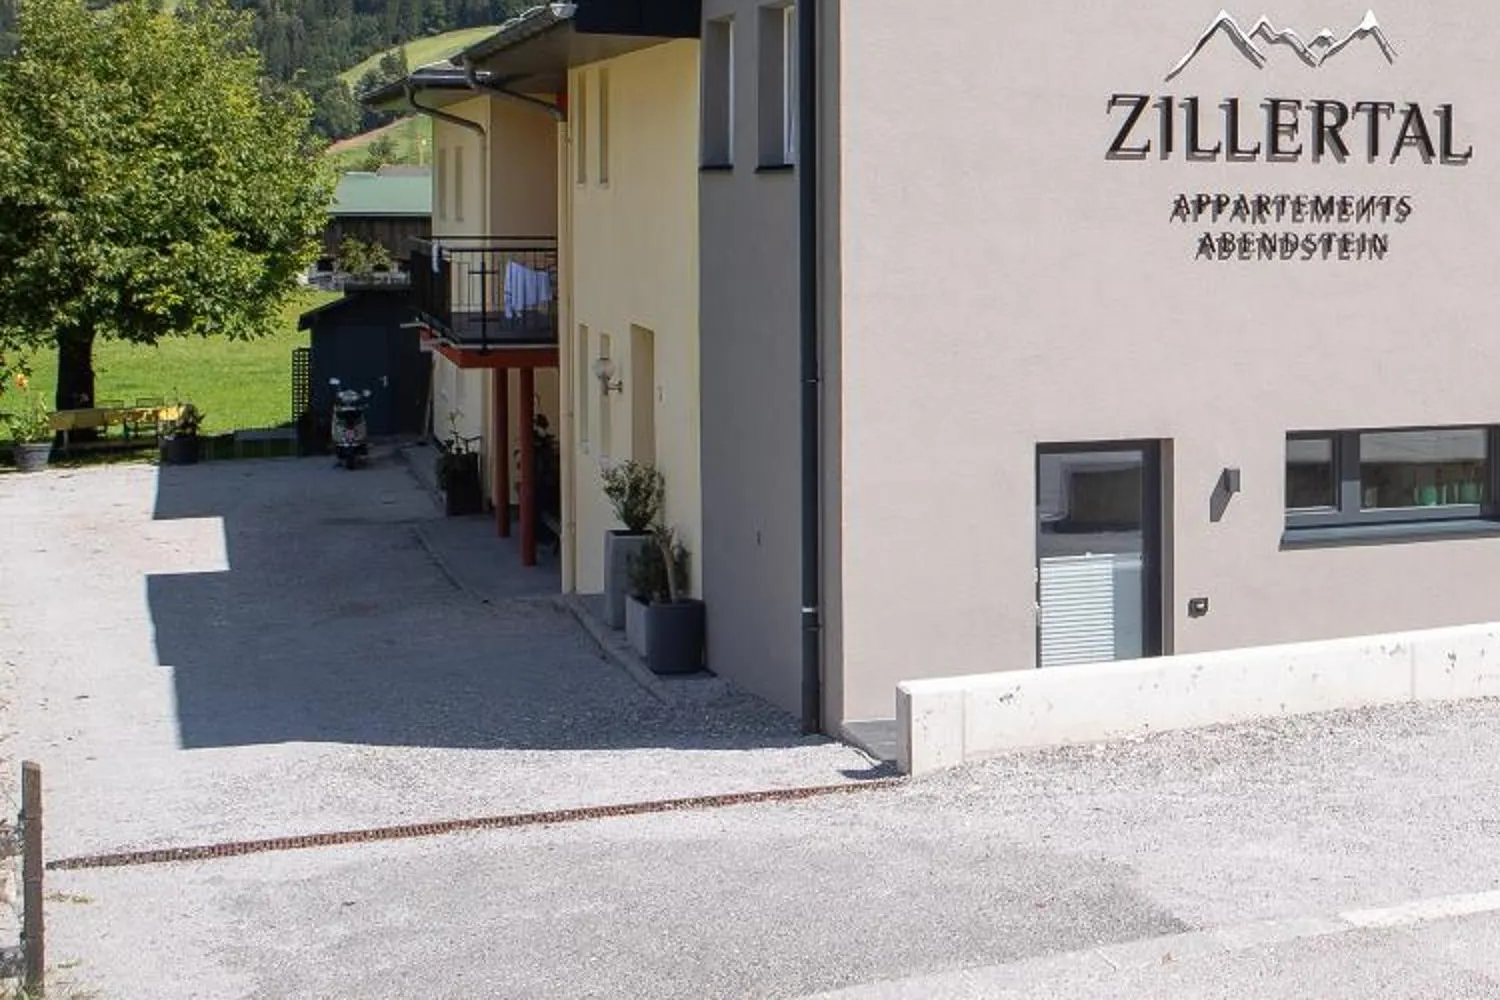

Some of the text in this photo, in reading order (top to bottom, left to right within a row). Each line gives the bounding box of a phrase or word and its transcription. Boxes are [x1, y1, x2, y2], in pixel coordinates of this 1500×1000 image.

[1107, 93, 1474, 162] ZILLERTAL
[1172, 193, 1413, 220] APPARTEMENTS
[1198, 231, 1390, 256] ABENDSTEIN
